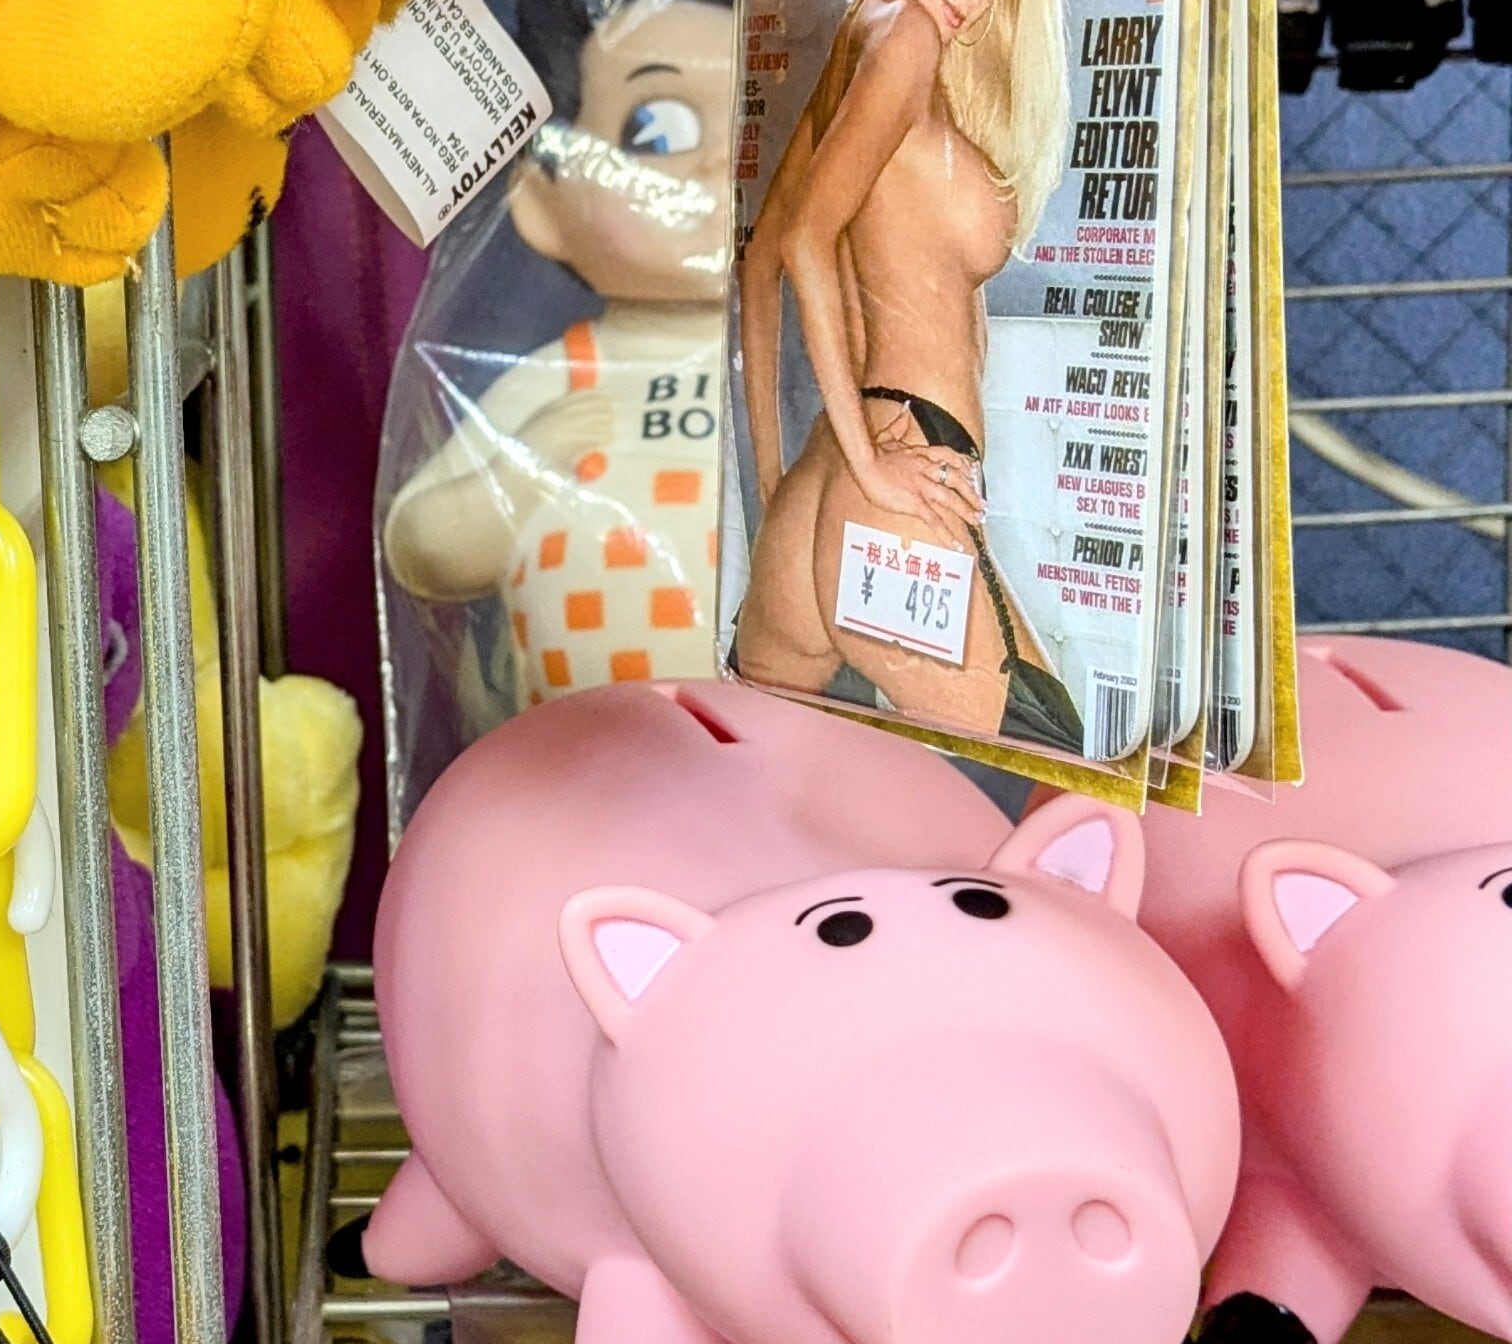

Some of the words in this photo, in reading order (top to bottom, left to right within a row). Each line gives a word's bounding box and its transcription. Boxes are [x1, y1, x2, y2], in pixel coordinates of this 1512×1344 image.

[421, 21, 438, 38] IN
[1080, 14, 1164, 67] LARRY
[433, 34, 501, 125] HANDCRAFTED
[502, 73, 524, 103] LOS
[1088, 67, 1163, 118] FLYNT
[346, 79, 410, 150] MATERIALS
[447, 131, 470, 162] 3754
[399, 149, 426, 178] NEW
[421, 178, 439, 197] ALL
[1076, 226, 1140, 244] CORPORATE
[1035, 246, 1056, 262] AND
[1059, 247, 1080, 263] THE
[1083, 247, 1124, 265] STOLEN
[1043, 286, 1077, 316] REAL
[1082, 288, 1141, 319] COLLEGE
[1098, 320, 1145, 350] SHOW
[1065, 365, 1108, 396] WACO
[1024, 395, 1039, 412] AN
[1042, 398, 1063, 414] ATF
[1065, 400, 1102, 418] AGENT
[1103, 403, 1140, 422] LOOKS
[1062, 440, 1094, 471] XXX
[1057, 474, 1082, 491] NEW
[1084, 477, 1133, 499] LEAGUES
[1076, 496, 1098, 514] SEX
[1101, 499, 1115, 516] TO
[1119, 502, 1141, 520] THE
[866, 542, 942, 584] 税込価格
[1072, 534, 1124, 568] PERIOD
[1036, 562, 1102, 588] MENSTRUAL
[904, 579, 952, 631] 495
[1061, 586, 1076, 604] GO
[1079, 590, 1108, 610] WITH
[1110, 593, 1133, 614] THE
